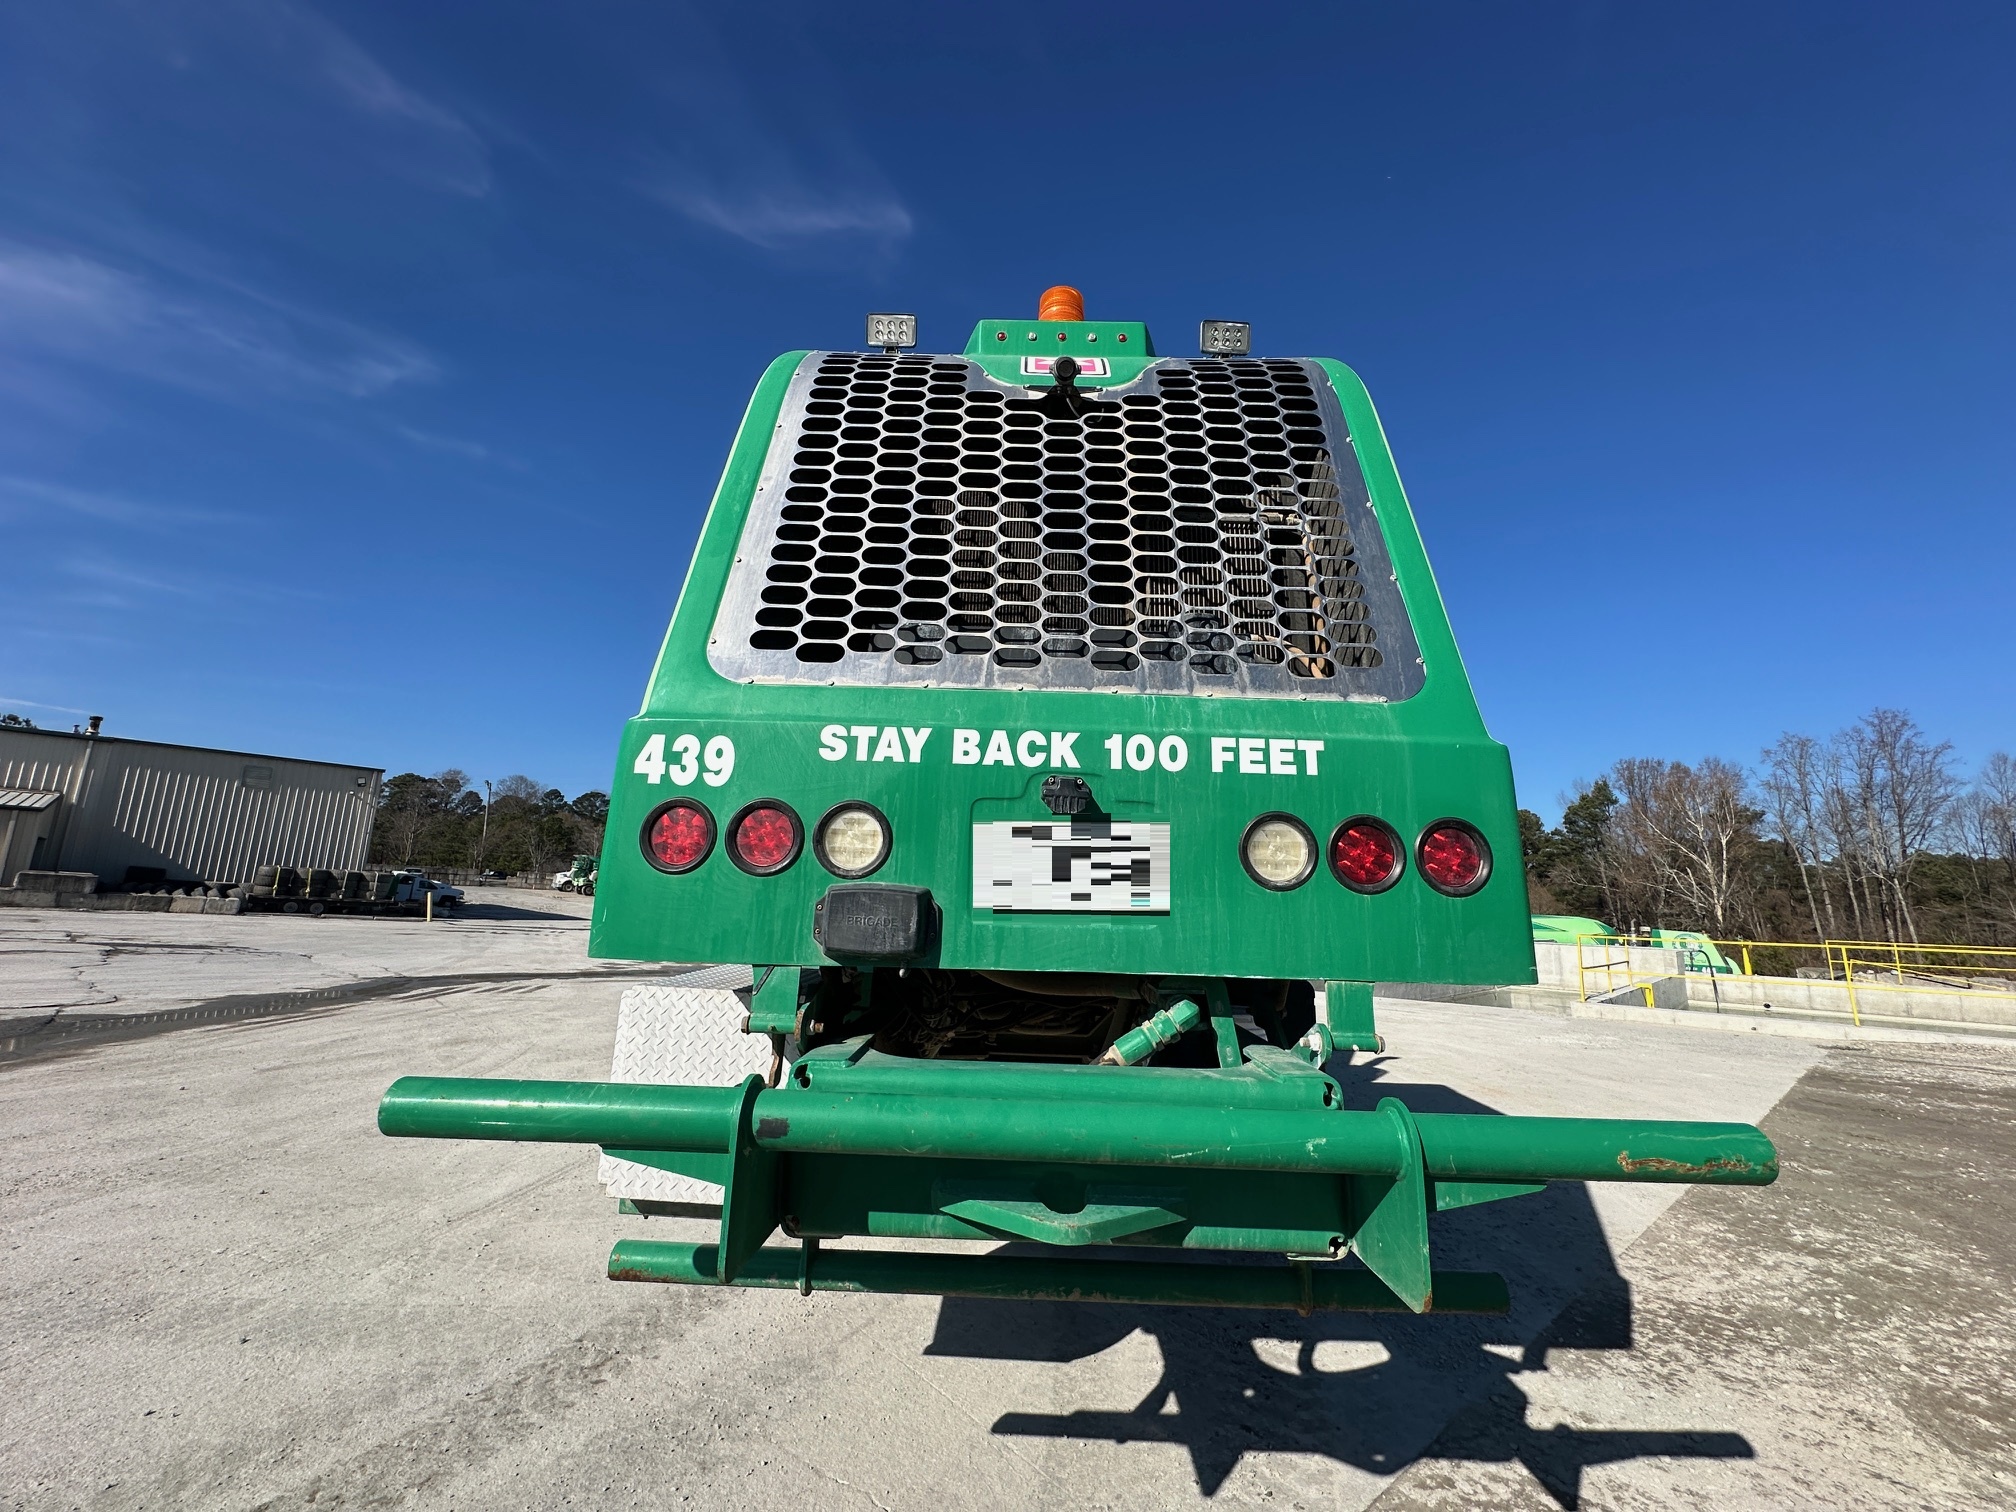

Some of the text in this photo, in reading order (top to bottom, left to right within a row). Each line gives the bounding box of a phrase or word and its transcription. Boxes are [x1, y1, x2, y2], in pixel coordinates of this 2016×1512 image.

[633, 734, 736, 787] 439
[818, 724, 1325, 776] STAY BACK 100 FEET
[846, 915, 899, 928] BRIGADE
